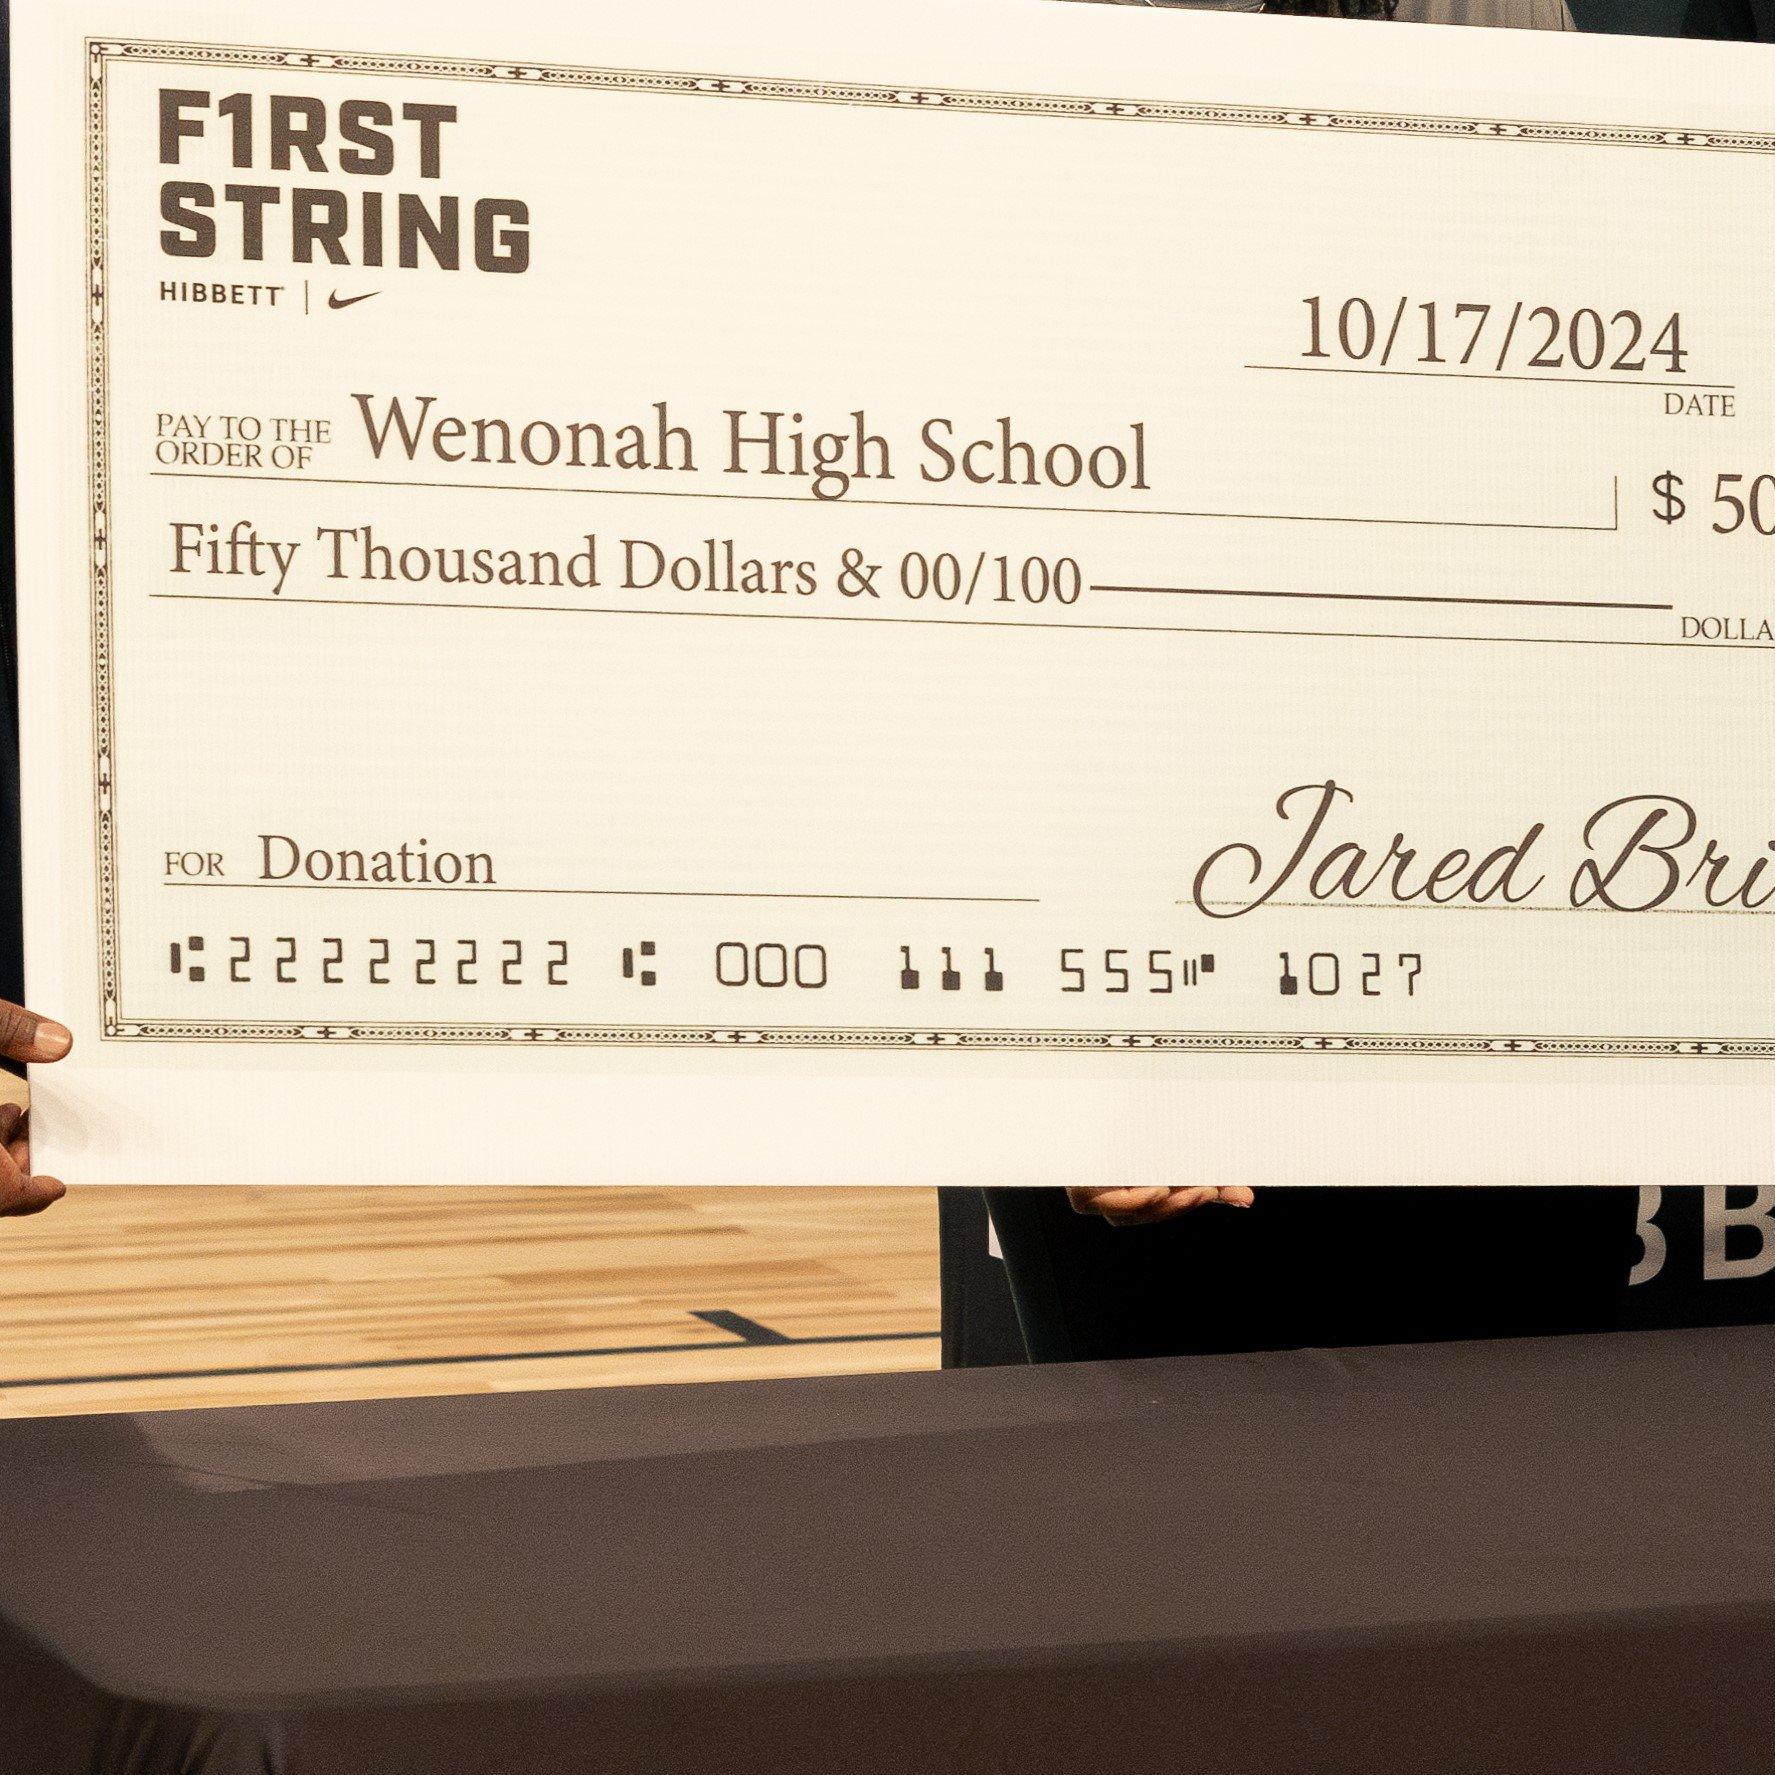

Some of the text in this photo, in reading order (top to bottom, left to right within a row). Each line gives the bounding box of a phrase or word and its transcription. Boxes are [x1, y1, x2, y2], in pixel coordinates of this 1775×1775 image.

[159, 181, 530, 274] STRING
[1300, 296, 1688, 372] 10/17/2024
[156, 413, 331, 444] PAY TO THE
[1665, 393, 1735, 417] DATE
[155, 439, 313, 469] ORDER OF
[351, 393, 1150, 501] Wenonah High School
[1652, 470, 1685, 525] $
[169, 521, 1081, 605] Fifty Thousand Dollars & 00/100
[165, 835, 496, 884] FOR Donation
[1193, 780, 1545, 918] Jared
[716, 942, 827, 989] 000
[1280, 952, 1421, 996] 1027
